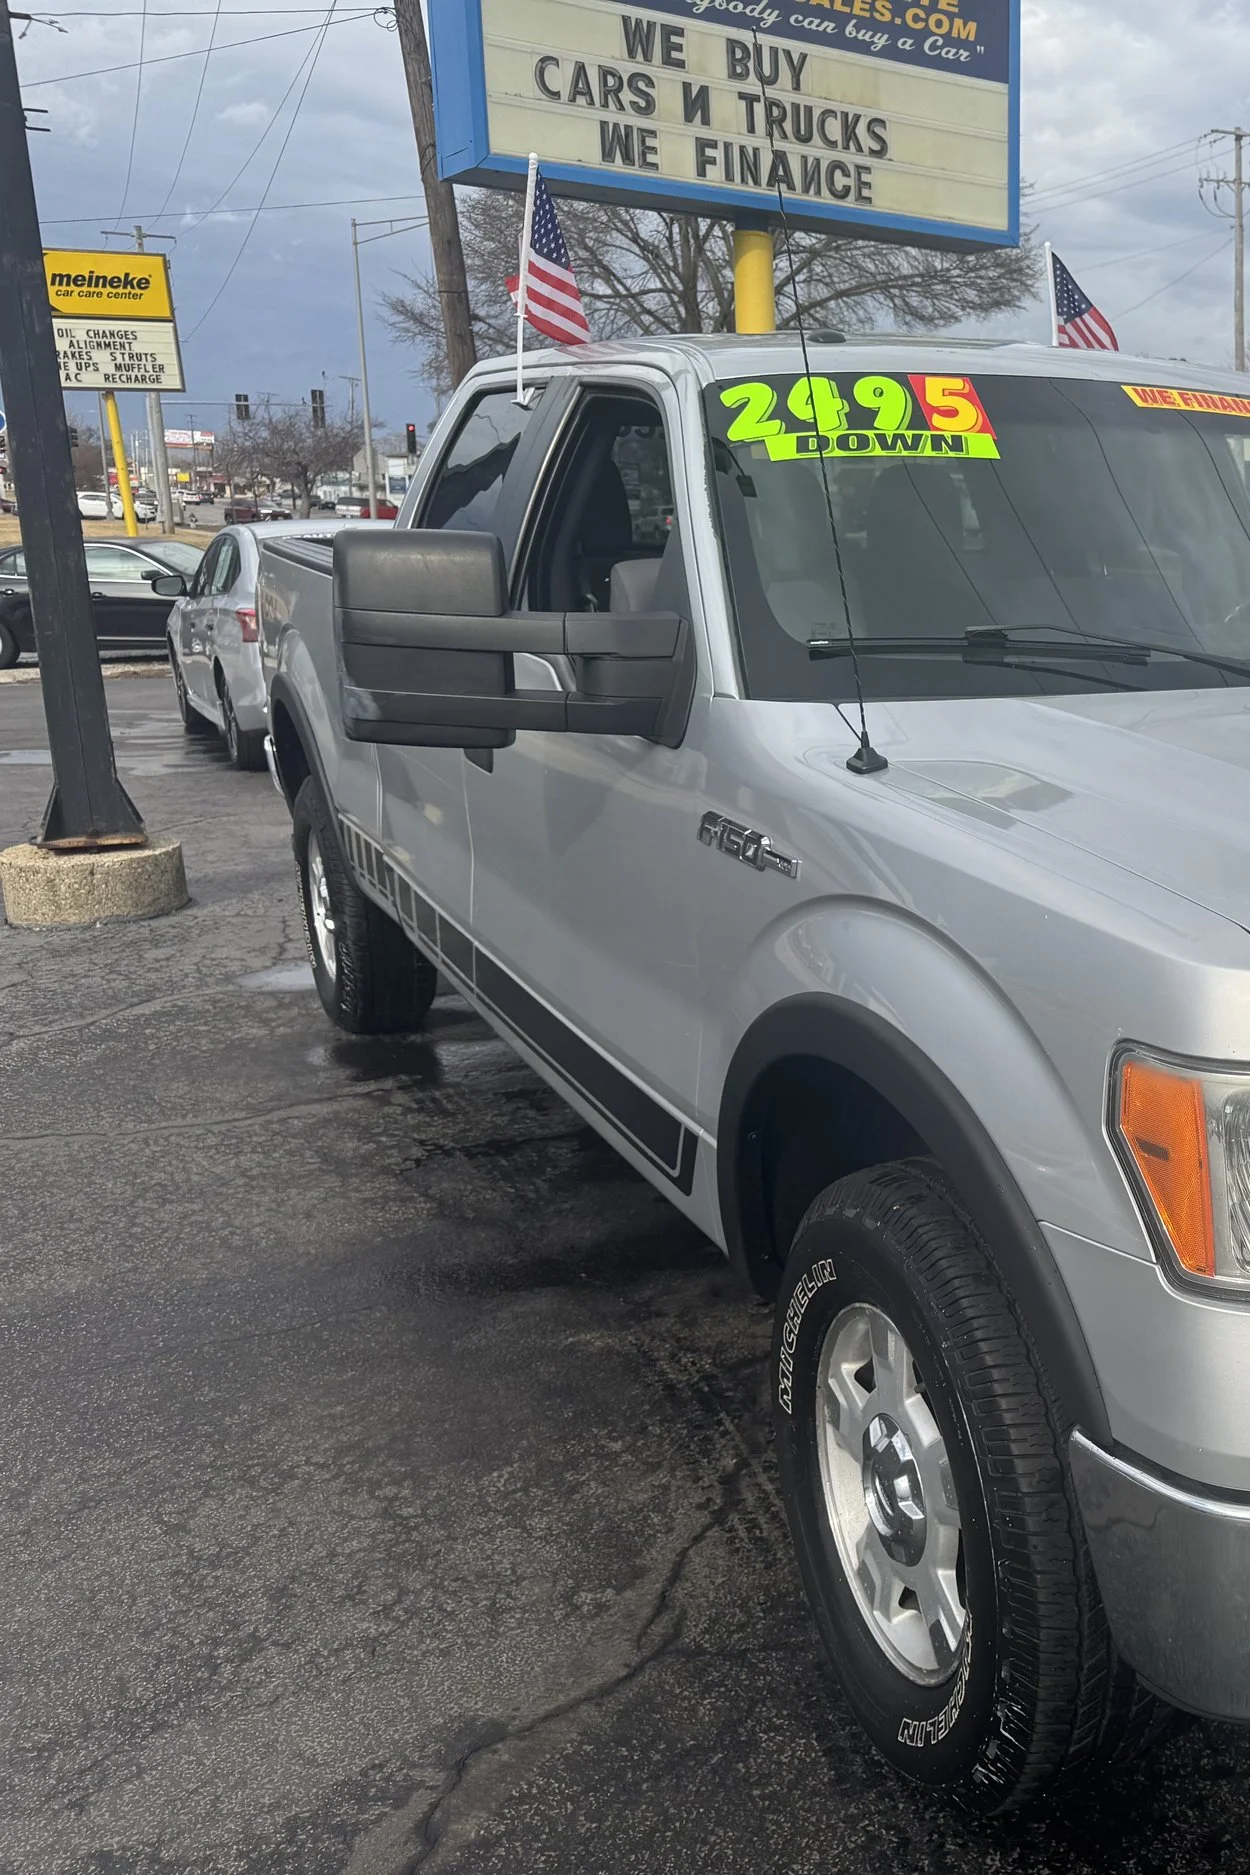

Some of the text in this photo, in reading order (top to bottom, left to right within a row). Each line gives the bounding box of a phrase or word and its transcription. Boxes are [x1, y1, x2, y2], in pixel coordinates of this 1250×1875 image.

[789, 13, 838, 34] can
[845, 19, 892, 52] buy
[897, 37, 916, 50] a
[621, 15, 808, 92] WE BUY
[534, 55, 656, 117] CARS
[737, 91, 888, 158] TRUCKS
[600, 121, 873, 204] WE FINANCE
[50, 270, 151, 290] meineke
[55, 289, 144, 300] car care center
[57, 328, 137, 340] OIL CHANGES
[56, 350, 93, 361] RAKES
[68, 340, 133, 351] ALIGNMENT
[76, 362, 99, 372] UPS
[114, 363, 165, 373] MUFFLER
[103, 373, 162, 384] RECHARGE
[1131, 387, 1179, 406] WE
[720, 376, 984, 442] 2495
[796, 433, 969, 455] DOWN
[778, 1259, 837, 1414] MICHELIN
